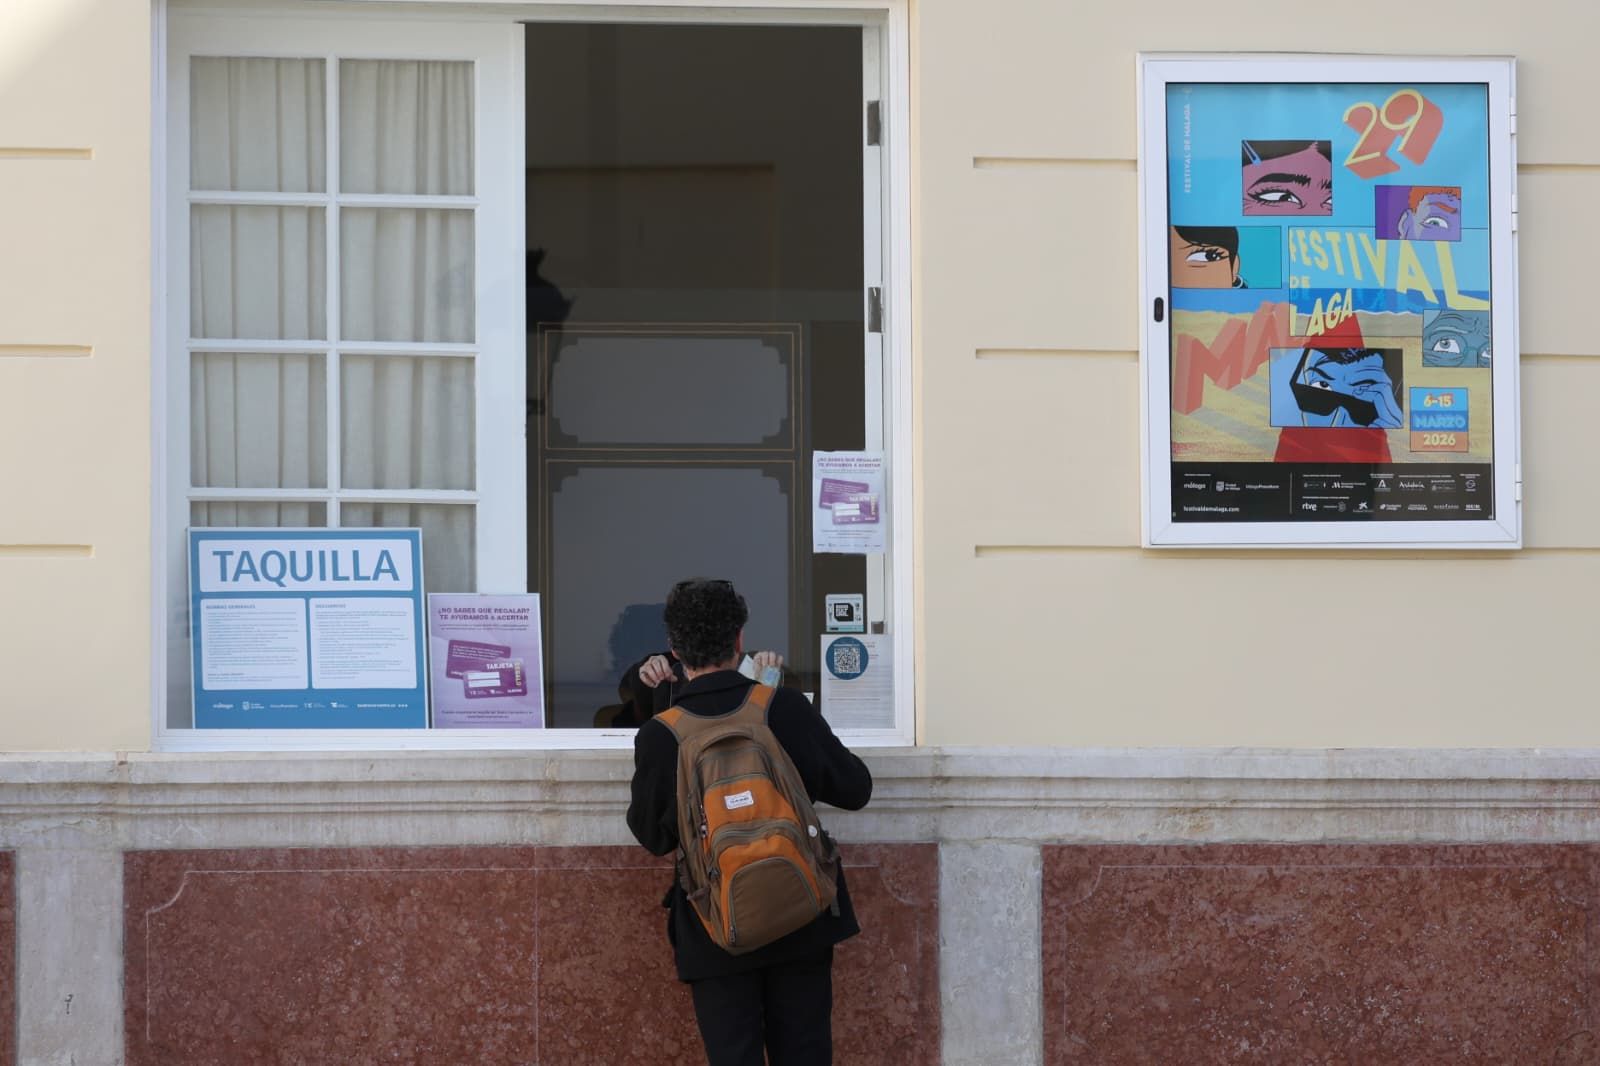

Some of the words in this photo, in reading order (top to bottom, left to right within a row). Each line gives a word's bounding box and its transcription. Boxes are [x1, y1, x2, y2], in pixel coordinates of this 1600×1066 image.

[1343, 88, 1427, 169] 29
[1289, 229, 1490, 311] FESTIVAL
[1424, 393, 1454, 408] 6-15
[1414, 414, 1466, 428] MARZO
[1424, 433, 1456, 446] 2026
[1302, 502, 1317, 511] rtve
[212, 550, 400, 587] TAQUILLA
